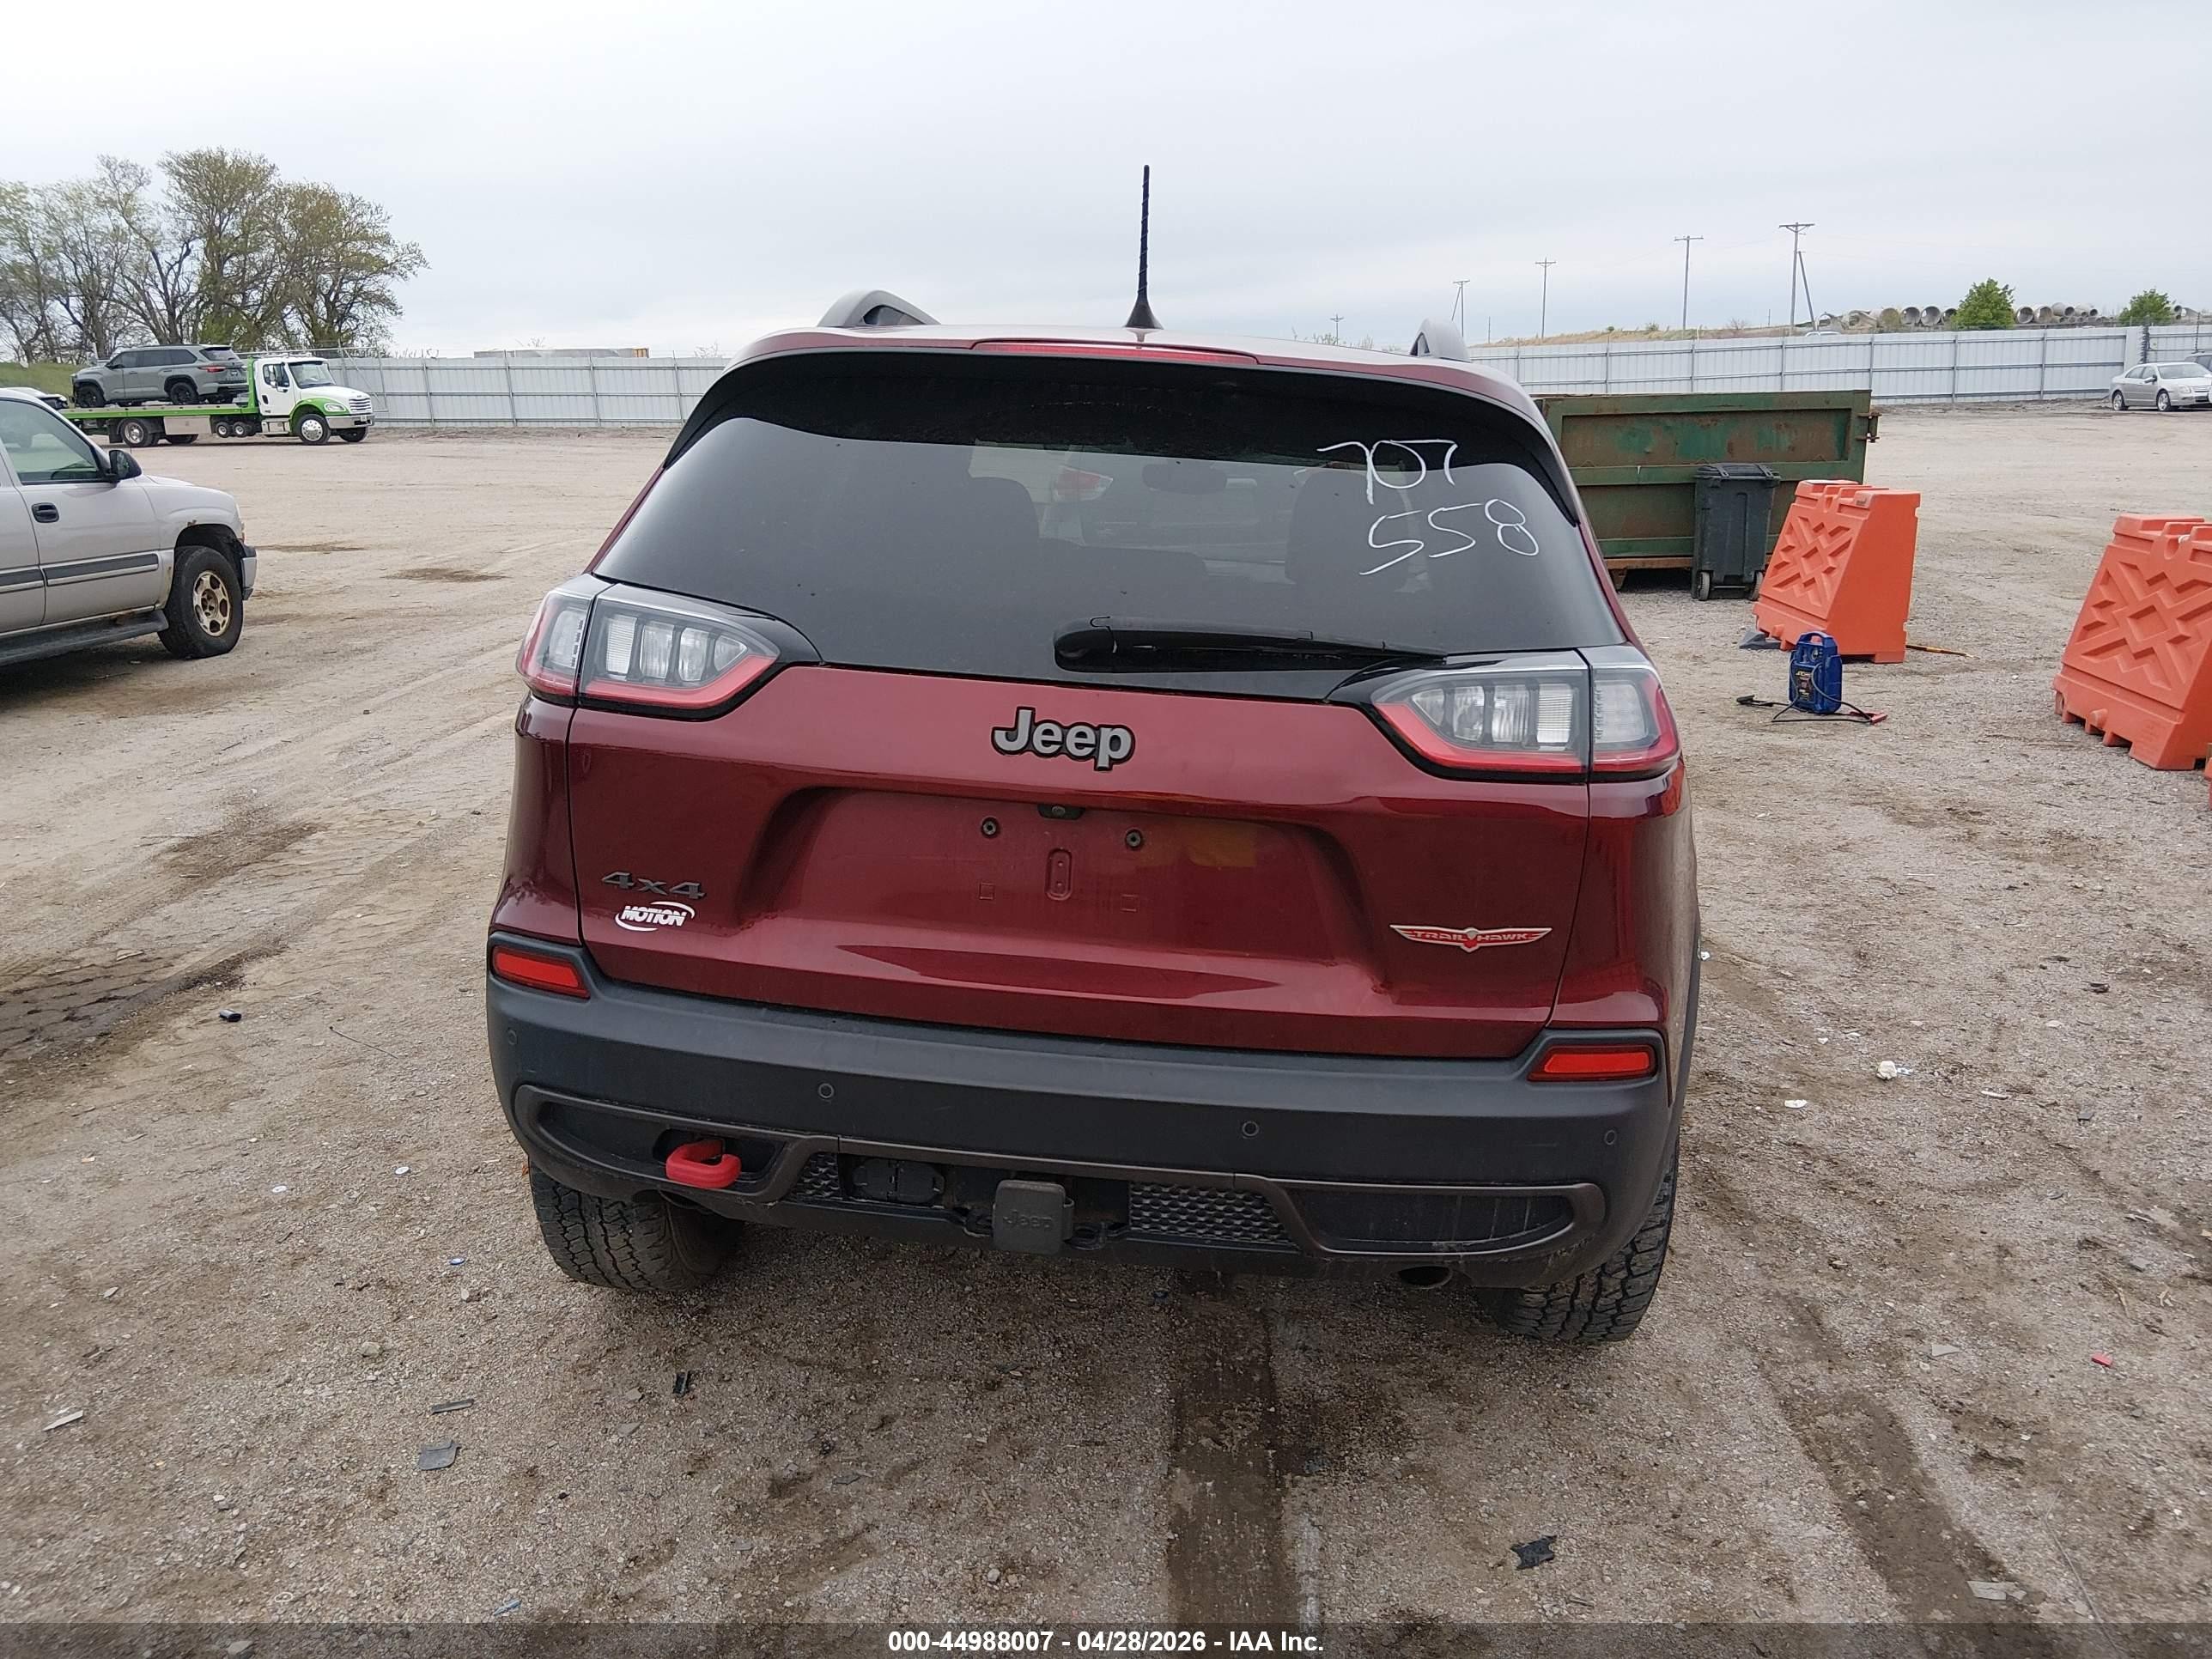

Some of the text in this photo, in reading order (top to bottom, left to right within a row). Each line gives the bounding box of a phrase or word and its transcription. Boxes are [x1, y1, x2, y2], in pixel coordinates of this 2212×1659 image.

[1316, 438, 1459, 506] 707
[1358, 498, 1540, 576] 558
[993, 707, 1134, 771] Jeep
[601, 871, 708, 900] 4x4
[620, 905, 688, 927] MOTION
